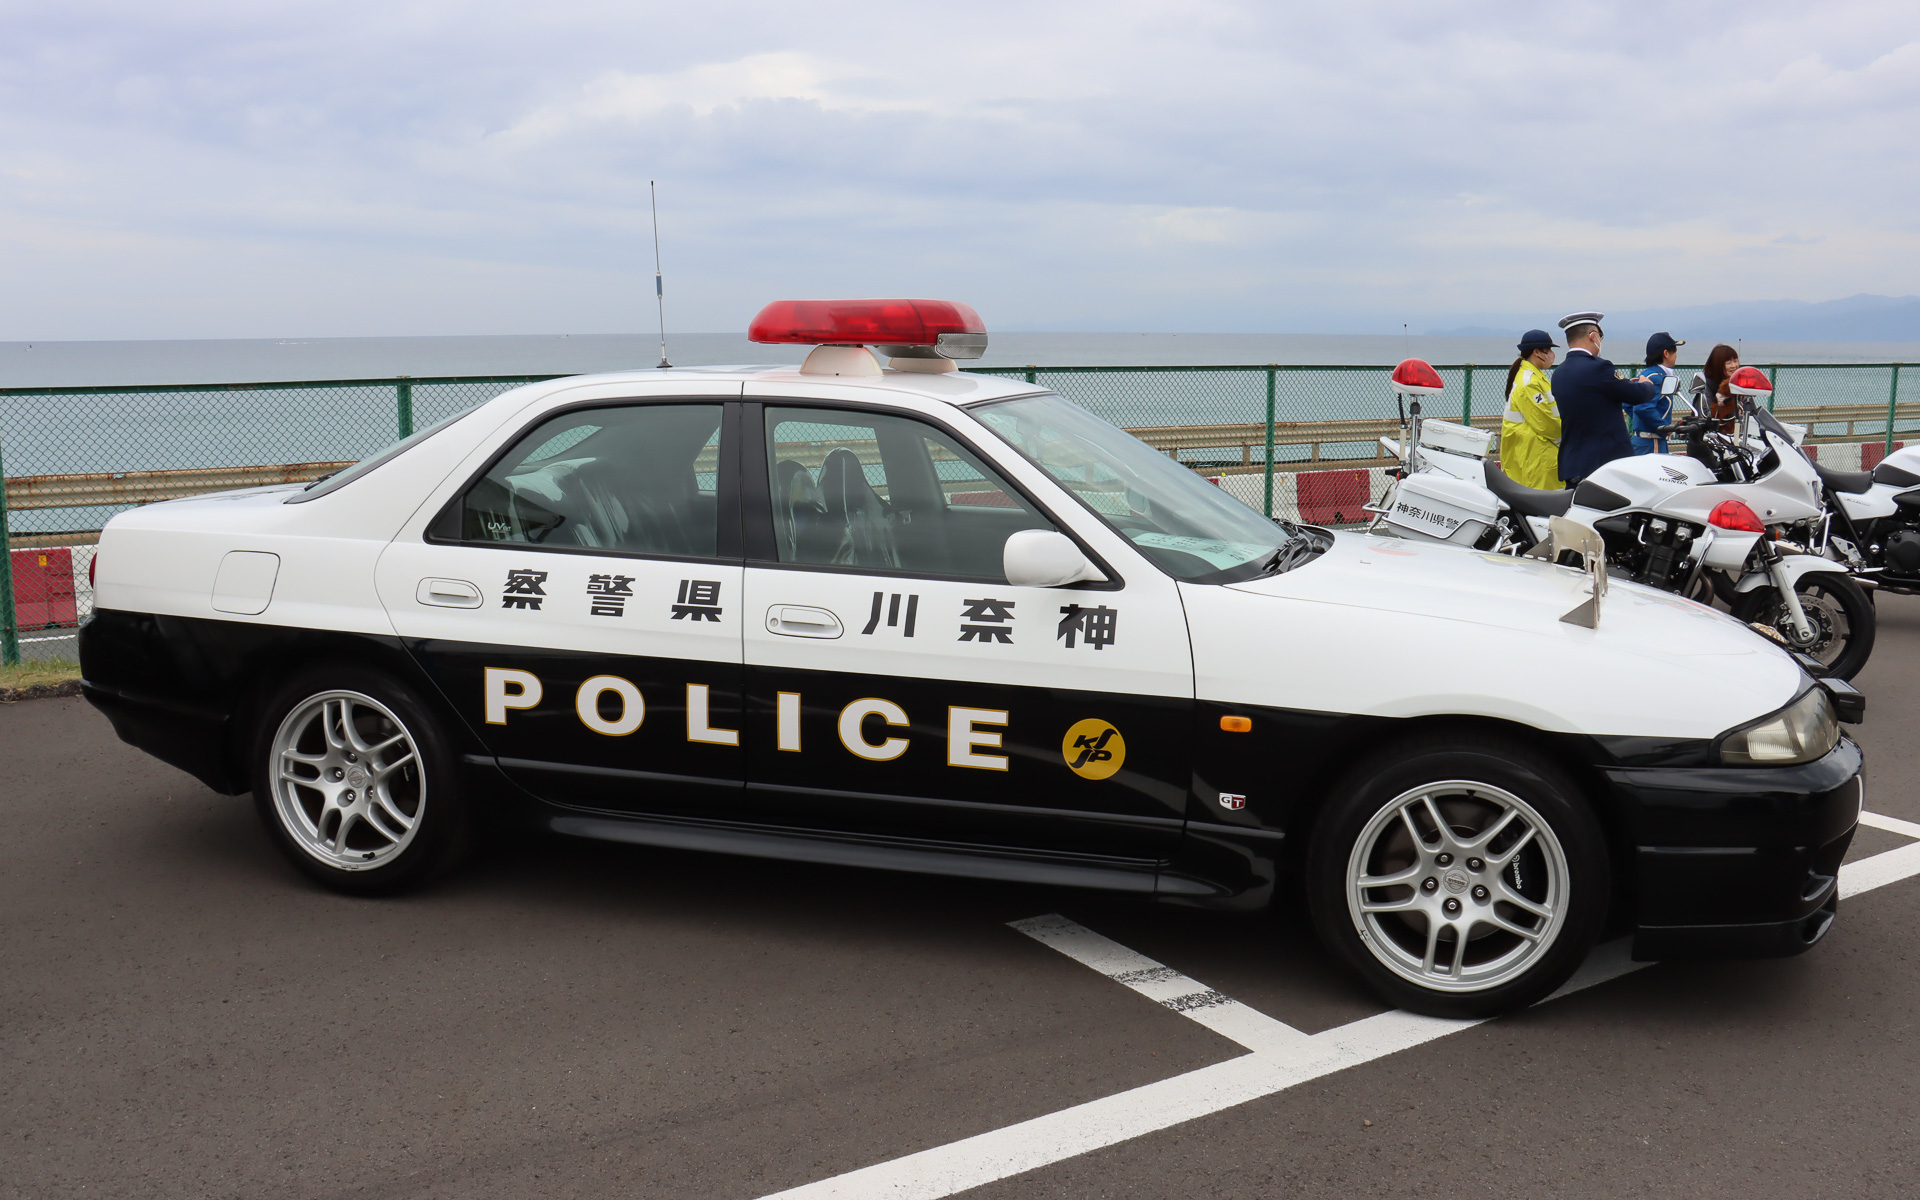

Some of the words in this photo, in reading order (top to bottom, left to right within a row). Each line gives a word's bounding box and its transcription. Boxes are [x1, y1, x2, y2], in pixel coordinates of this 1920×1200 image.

[1658, 477, 1688, 486] HONDA
[1396, 501, 1460, 530] 神奈川県警
[483, 665, 1009, 772] POLICE
[1221, 796, 1243, 808] GT
[1512, 862, 1523, 890] brembo
